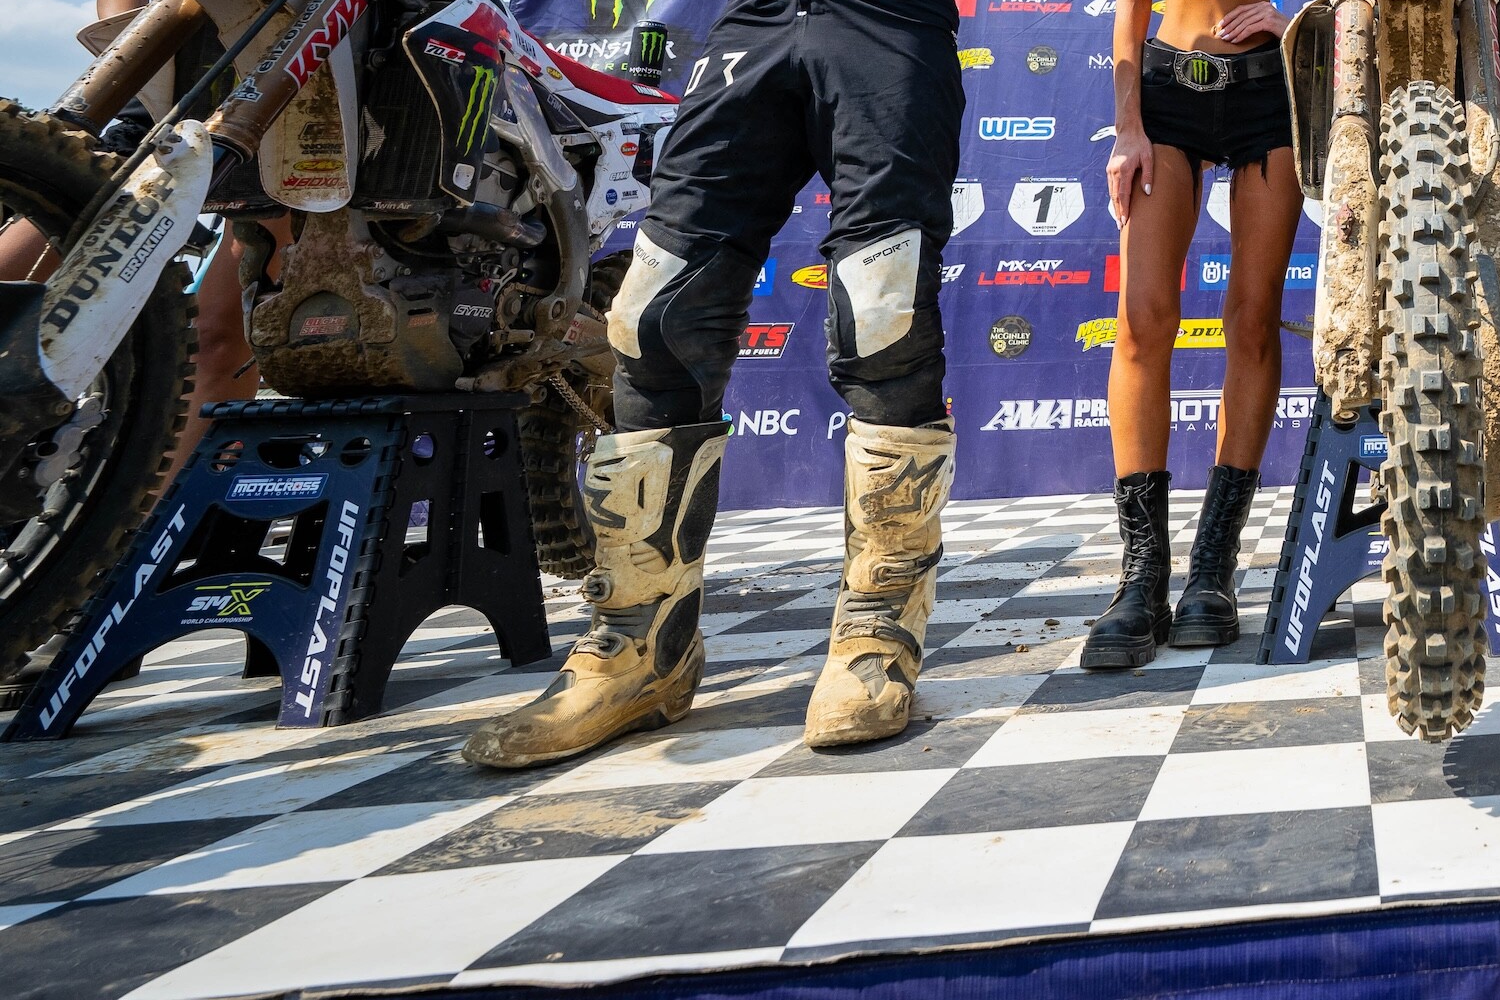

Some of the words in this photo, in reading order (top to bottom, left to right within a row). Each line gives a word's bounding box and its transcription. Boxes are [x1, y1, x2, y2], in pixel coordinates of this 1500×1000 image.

[988, 2, 1073, 14] LEGENDS
[546, 38, 677, 62] MONSTR
[979, 116, 1056, 142] WPS
[202, 203, 223, 212] win
[374, 201, 395, 210] Twin
[397, 202, 412, 210] Air
[120, 216, 174, 283] BRAKING
[862, 239, 911, 267] SPORT
[977, 271, 1091, 288] LEGENDS
[454, 304, 493, 319] GYTR
[1008, 338, 1030, 346] CLINIC
[752, 348, 780, 357] FUELS
[738, 409, 800, 436] NBC
[980, 398, 1074, 431] AMA
[231, 489, 318, 498] CHAMPIONSHIP
[233, 480, 322, 493] MOTOCROSS
[1284, 459, 1336, 656] UFOPLAST
[186, 588, 264, 617] SMX
[294, 500, 359, 718] UFOPLAST
[39, 503, 186, 731] UFOPLAST
[180, 617, 203, 625] WORLD
[203, 616, 254, 625] CHAMPIONSHIP
